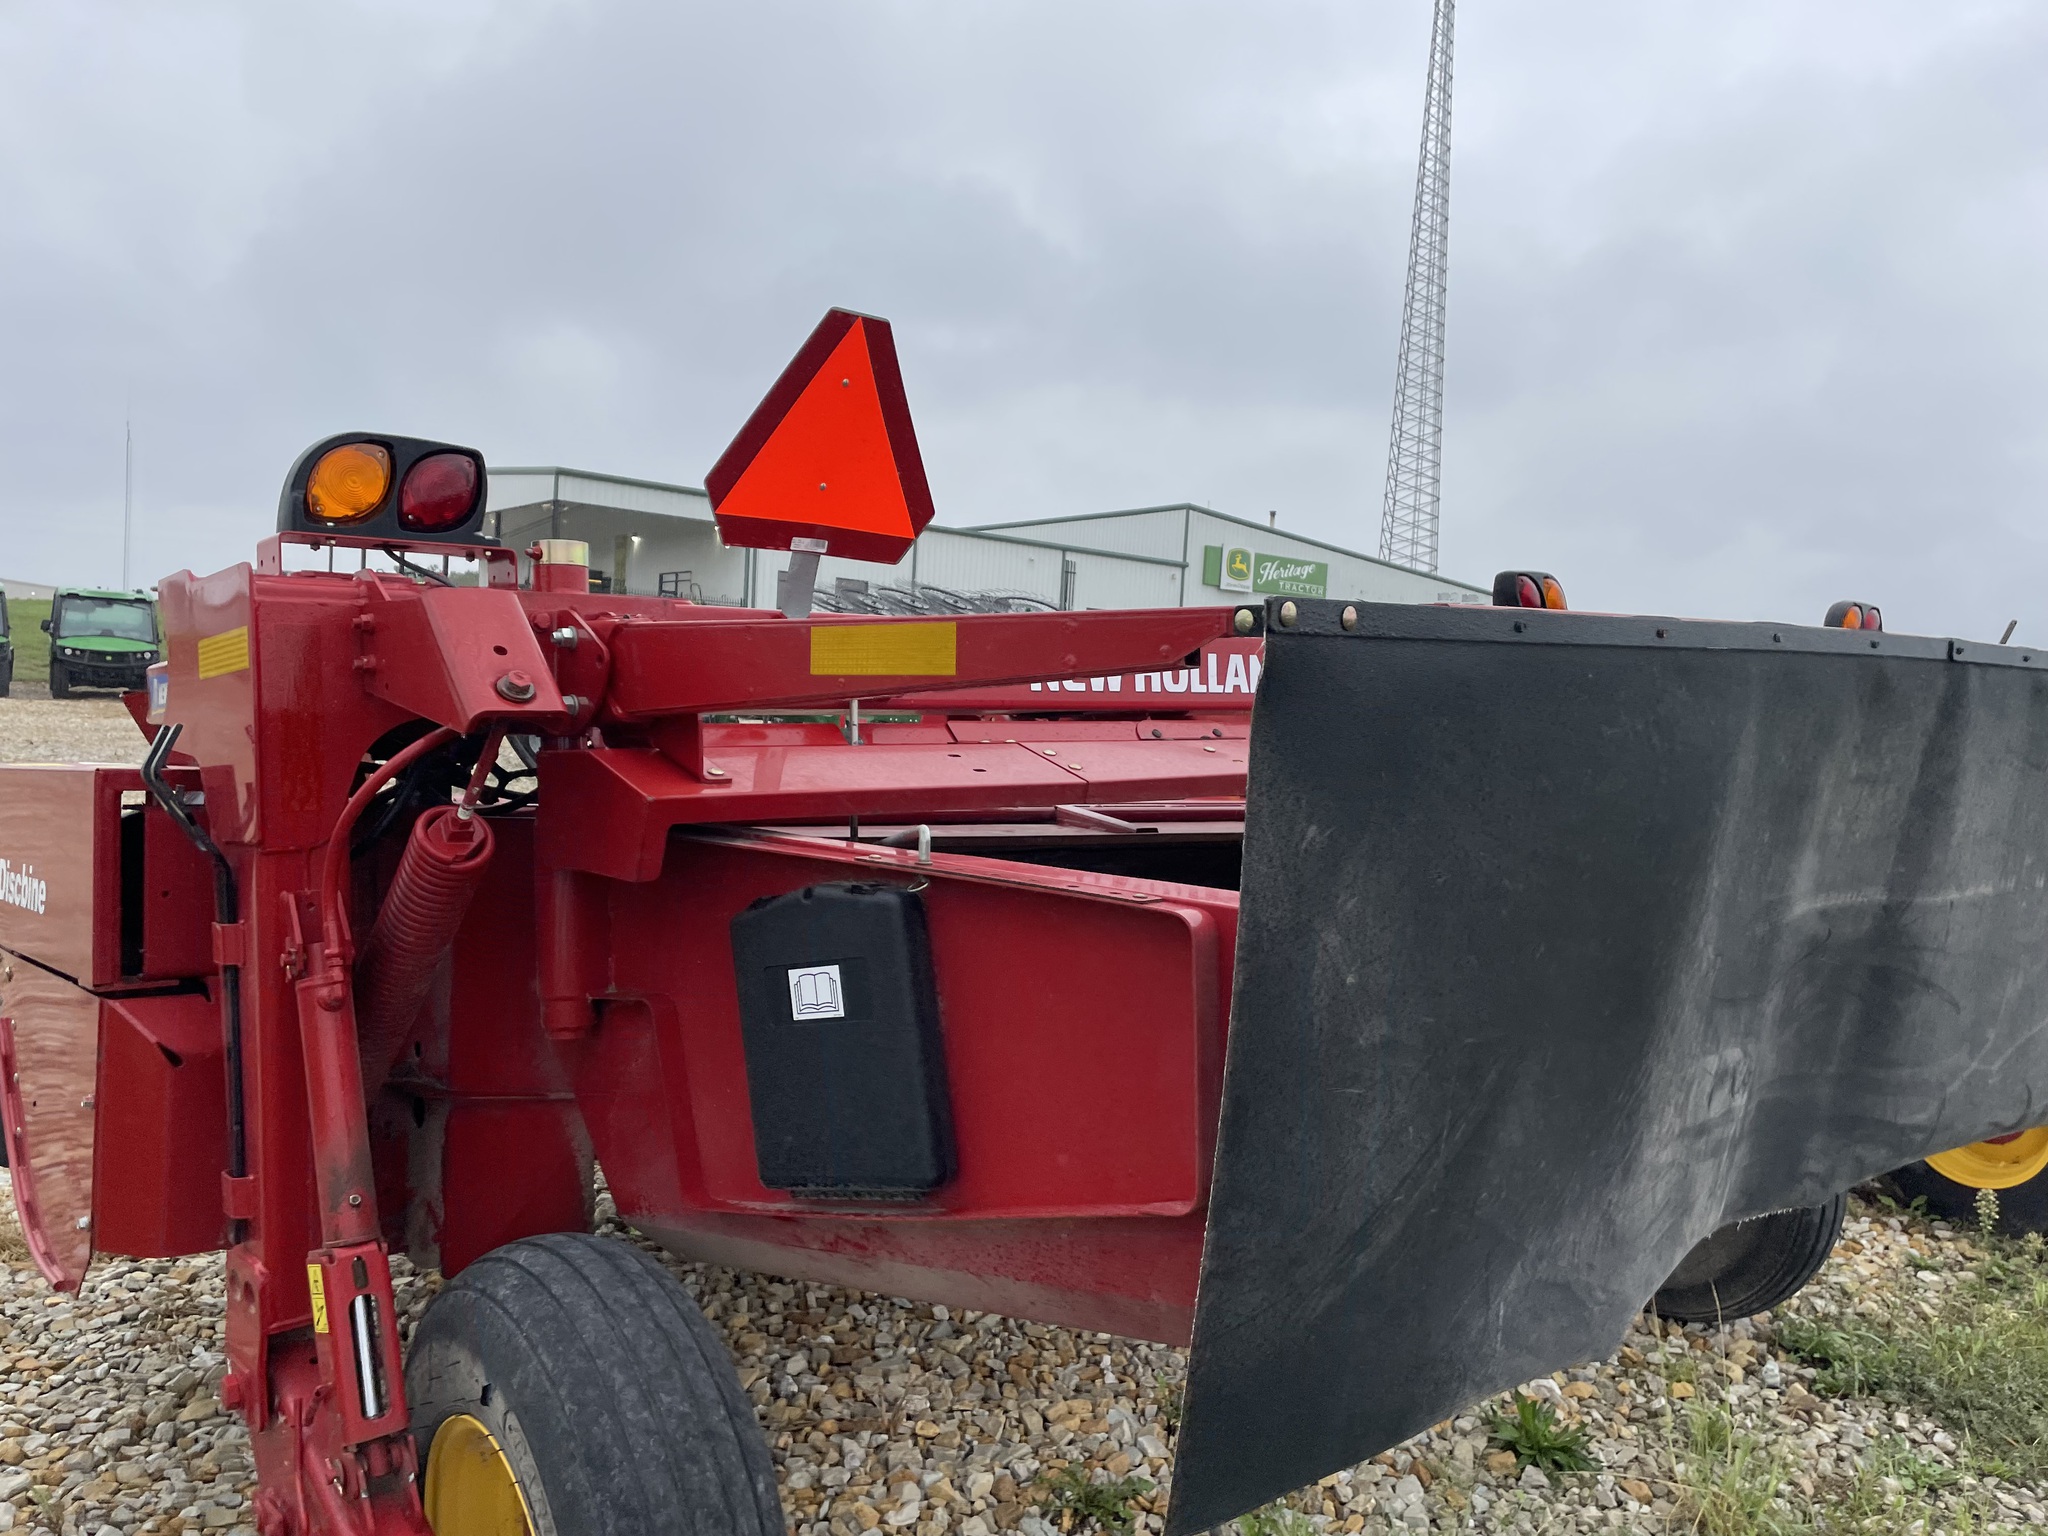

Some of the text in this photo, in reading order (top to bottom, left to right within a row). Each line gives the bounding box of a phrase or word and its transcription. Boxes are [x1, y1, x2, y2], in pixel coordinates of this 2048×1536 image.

[1257, 560, 1316, 584] Heritage
[1279, 581, 1324, 595] TRACTOR
[0, 858, 47, 915] Discbine
